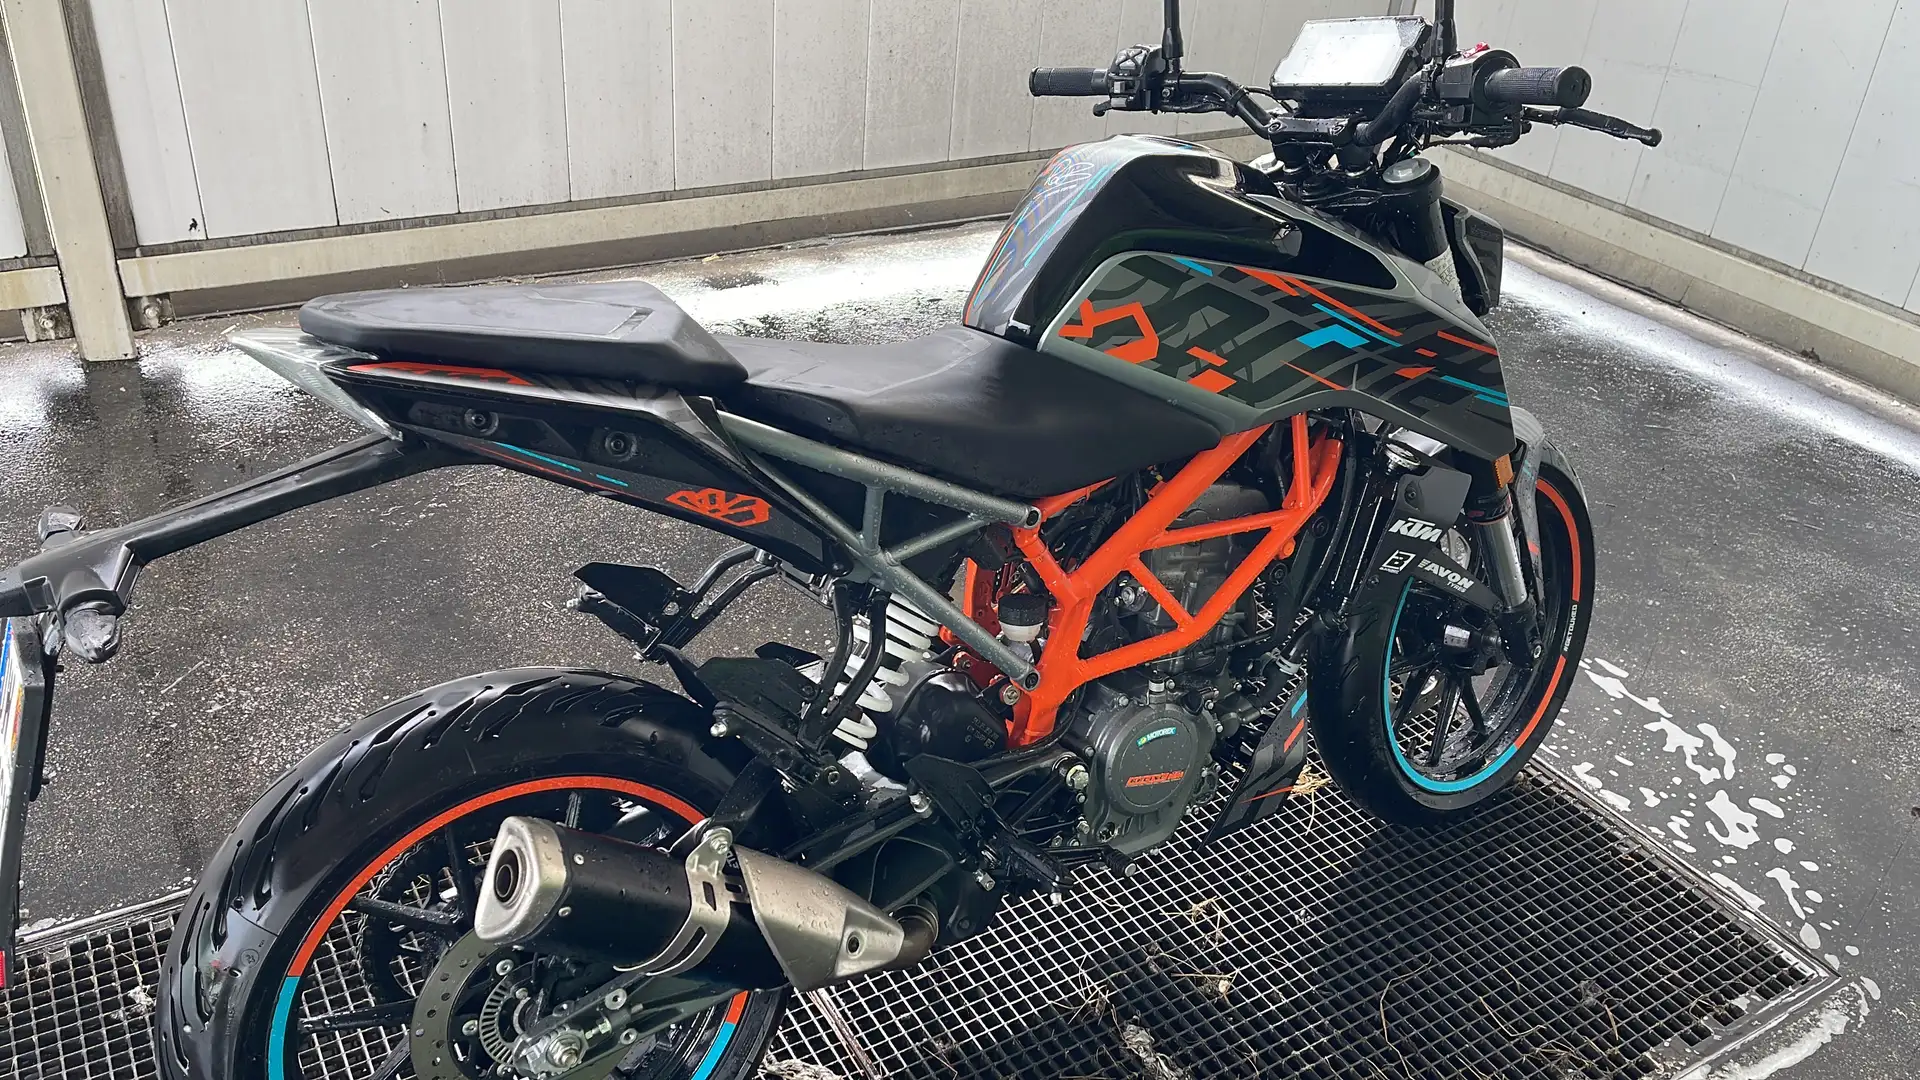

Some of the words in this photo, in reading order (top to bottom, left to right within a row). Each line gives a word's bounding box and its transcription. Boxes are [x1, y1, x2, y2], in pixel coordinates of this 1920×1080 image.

[1388, 517, 1443, 542] KTM
[1424, 562, 1475, 589] AVON
[1147, 727, 1177, 741] MOTOREX
